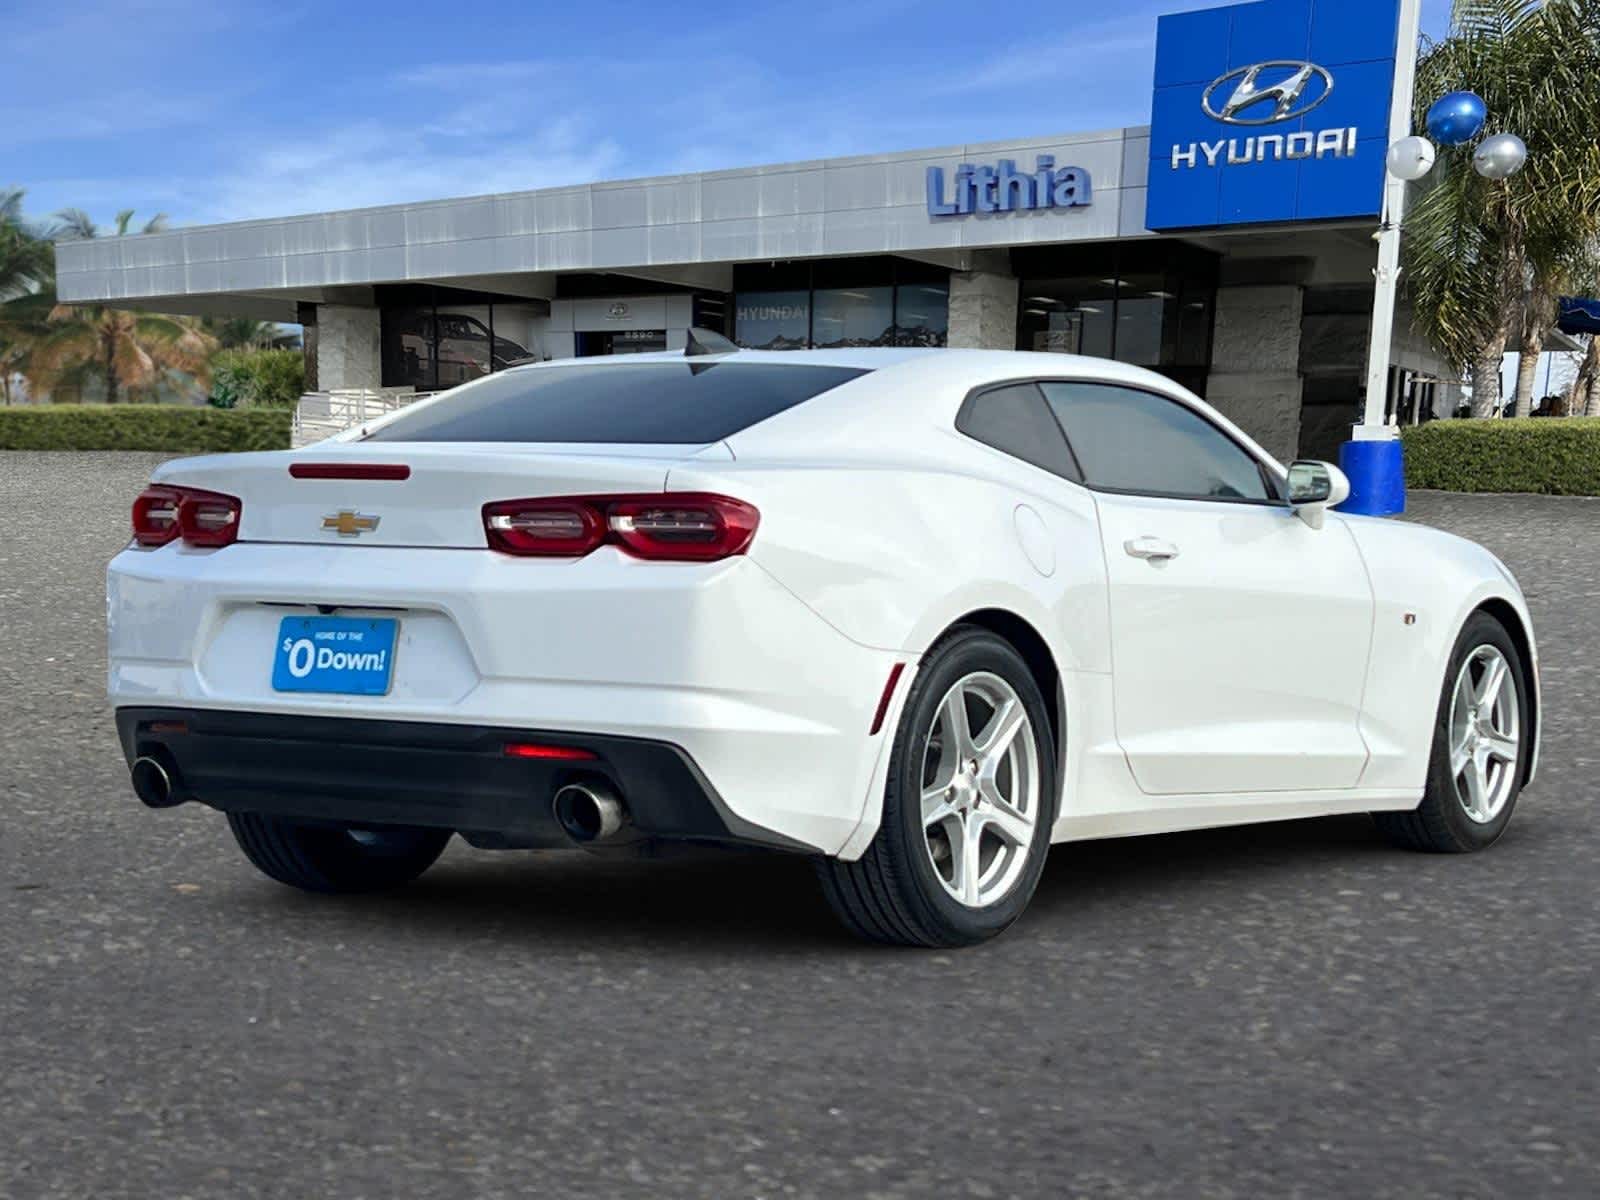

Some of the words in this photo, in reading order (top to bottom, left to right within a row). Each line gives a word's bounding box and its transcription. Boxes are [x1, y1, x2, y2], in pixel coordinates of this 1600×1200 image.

[1171, 127, 1358, 169] HYUNDAI
[926, 155, 1092, 216] Lithia
[736, 304, 808, 320] HYUNDAI
[348, 631, 364, 641] THE
[316, 648, 386, 671] Down!
